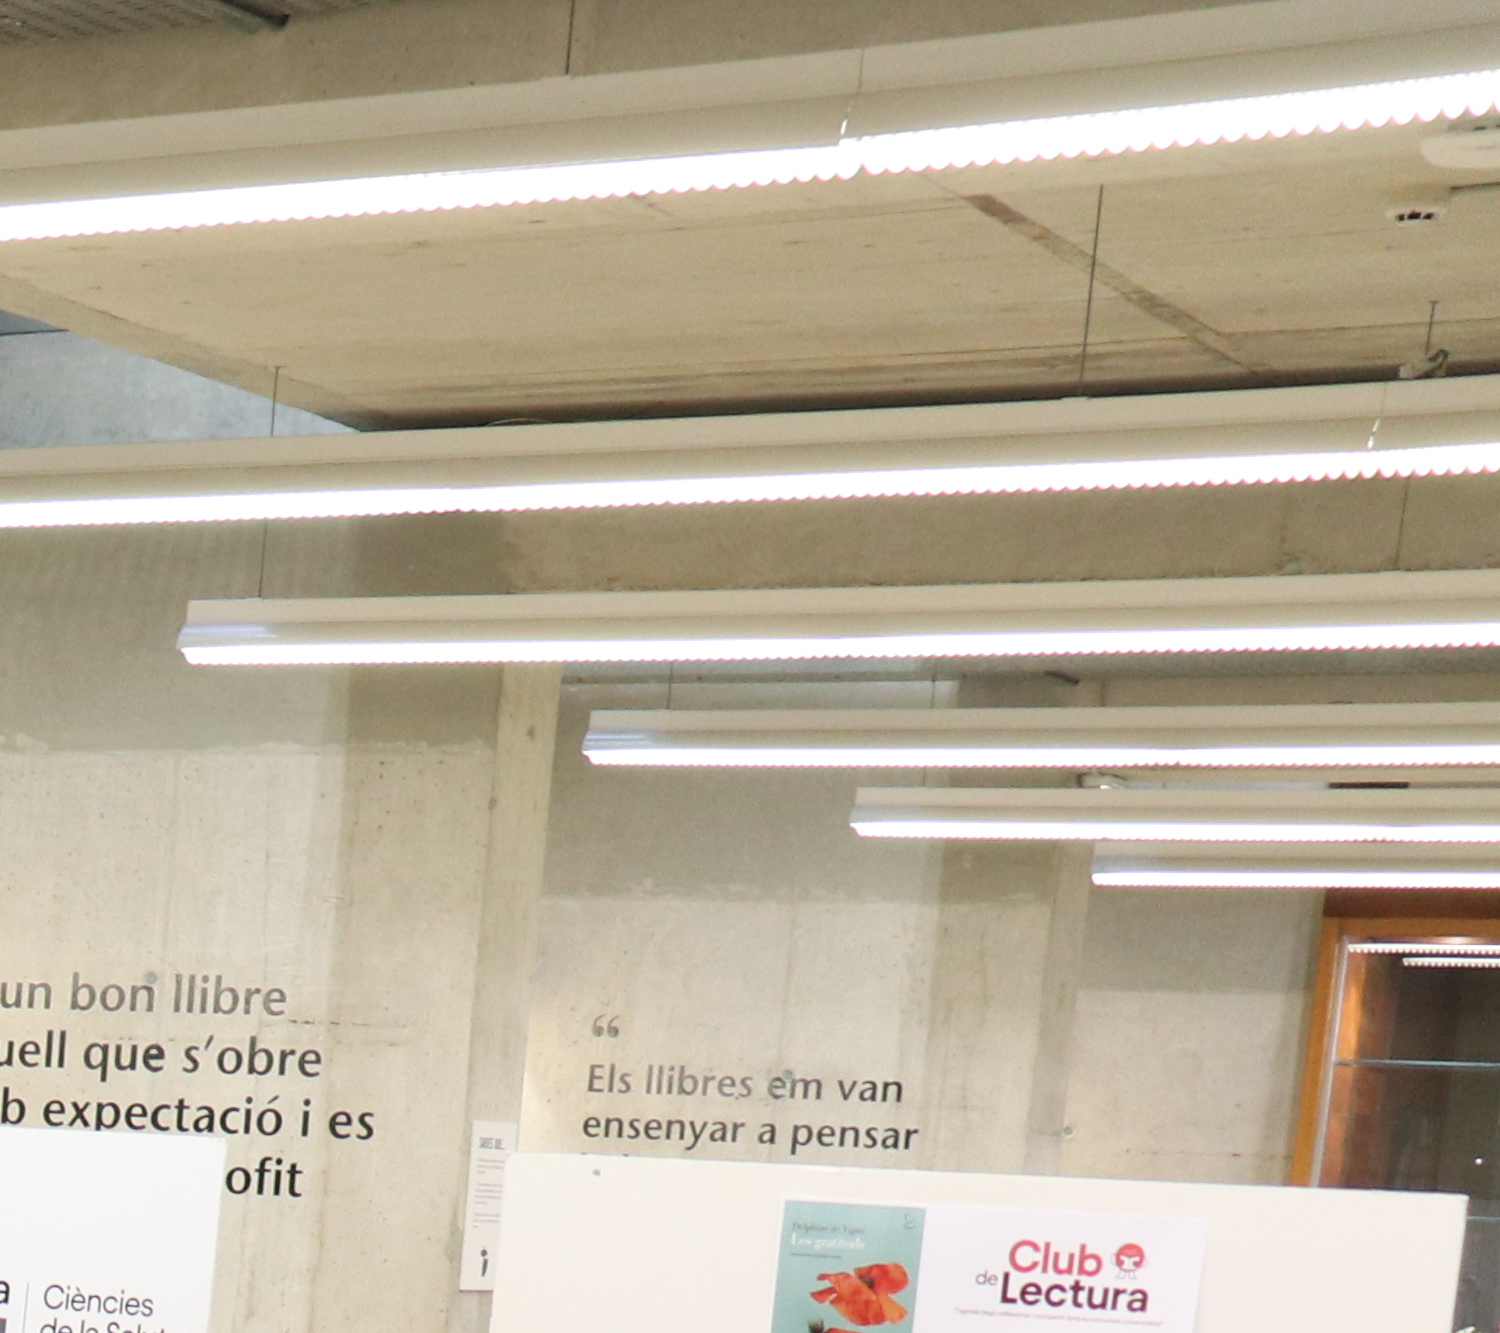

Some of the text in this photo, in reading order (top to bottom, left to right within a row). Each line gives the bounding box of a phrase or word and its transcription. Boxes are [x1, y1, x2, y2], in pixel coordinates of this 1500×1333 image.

[0, 982, 52, 1011] un
[70, 971, 155, 1013] bon
[173, 973, 287, 1017] llibre
[83, 1040, 166, 1082] que
[181, 1034, 323, 1078] s'obre
[587, 1063, 903, 1103] Els llibres em van
[42, 1097, 283, 1138] expectació
[300, 1099, 311, 1137] i
[328, 1107, 375, 1141] es
[582, 1115, 919, 1156] ensenyar a pensar
[224, 1156, 302, 1198] ofit
[1008, 1239, 1103, 1277] Club
[43, 1284, 155, 1318] Ciències
[975, 1270, 1149, 1313] de Lectura
